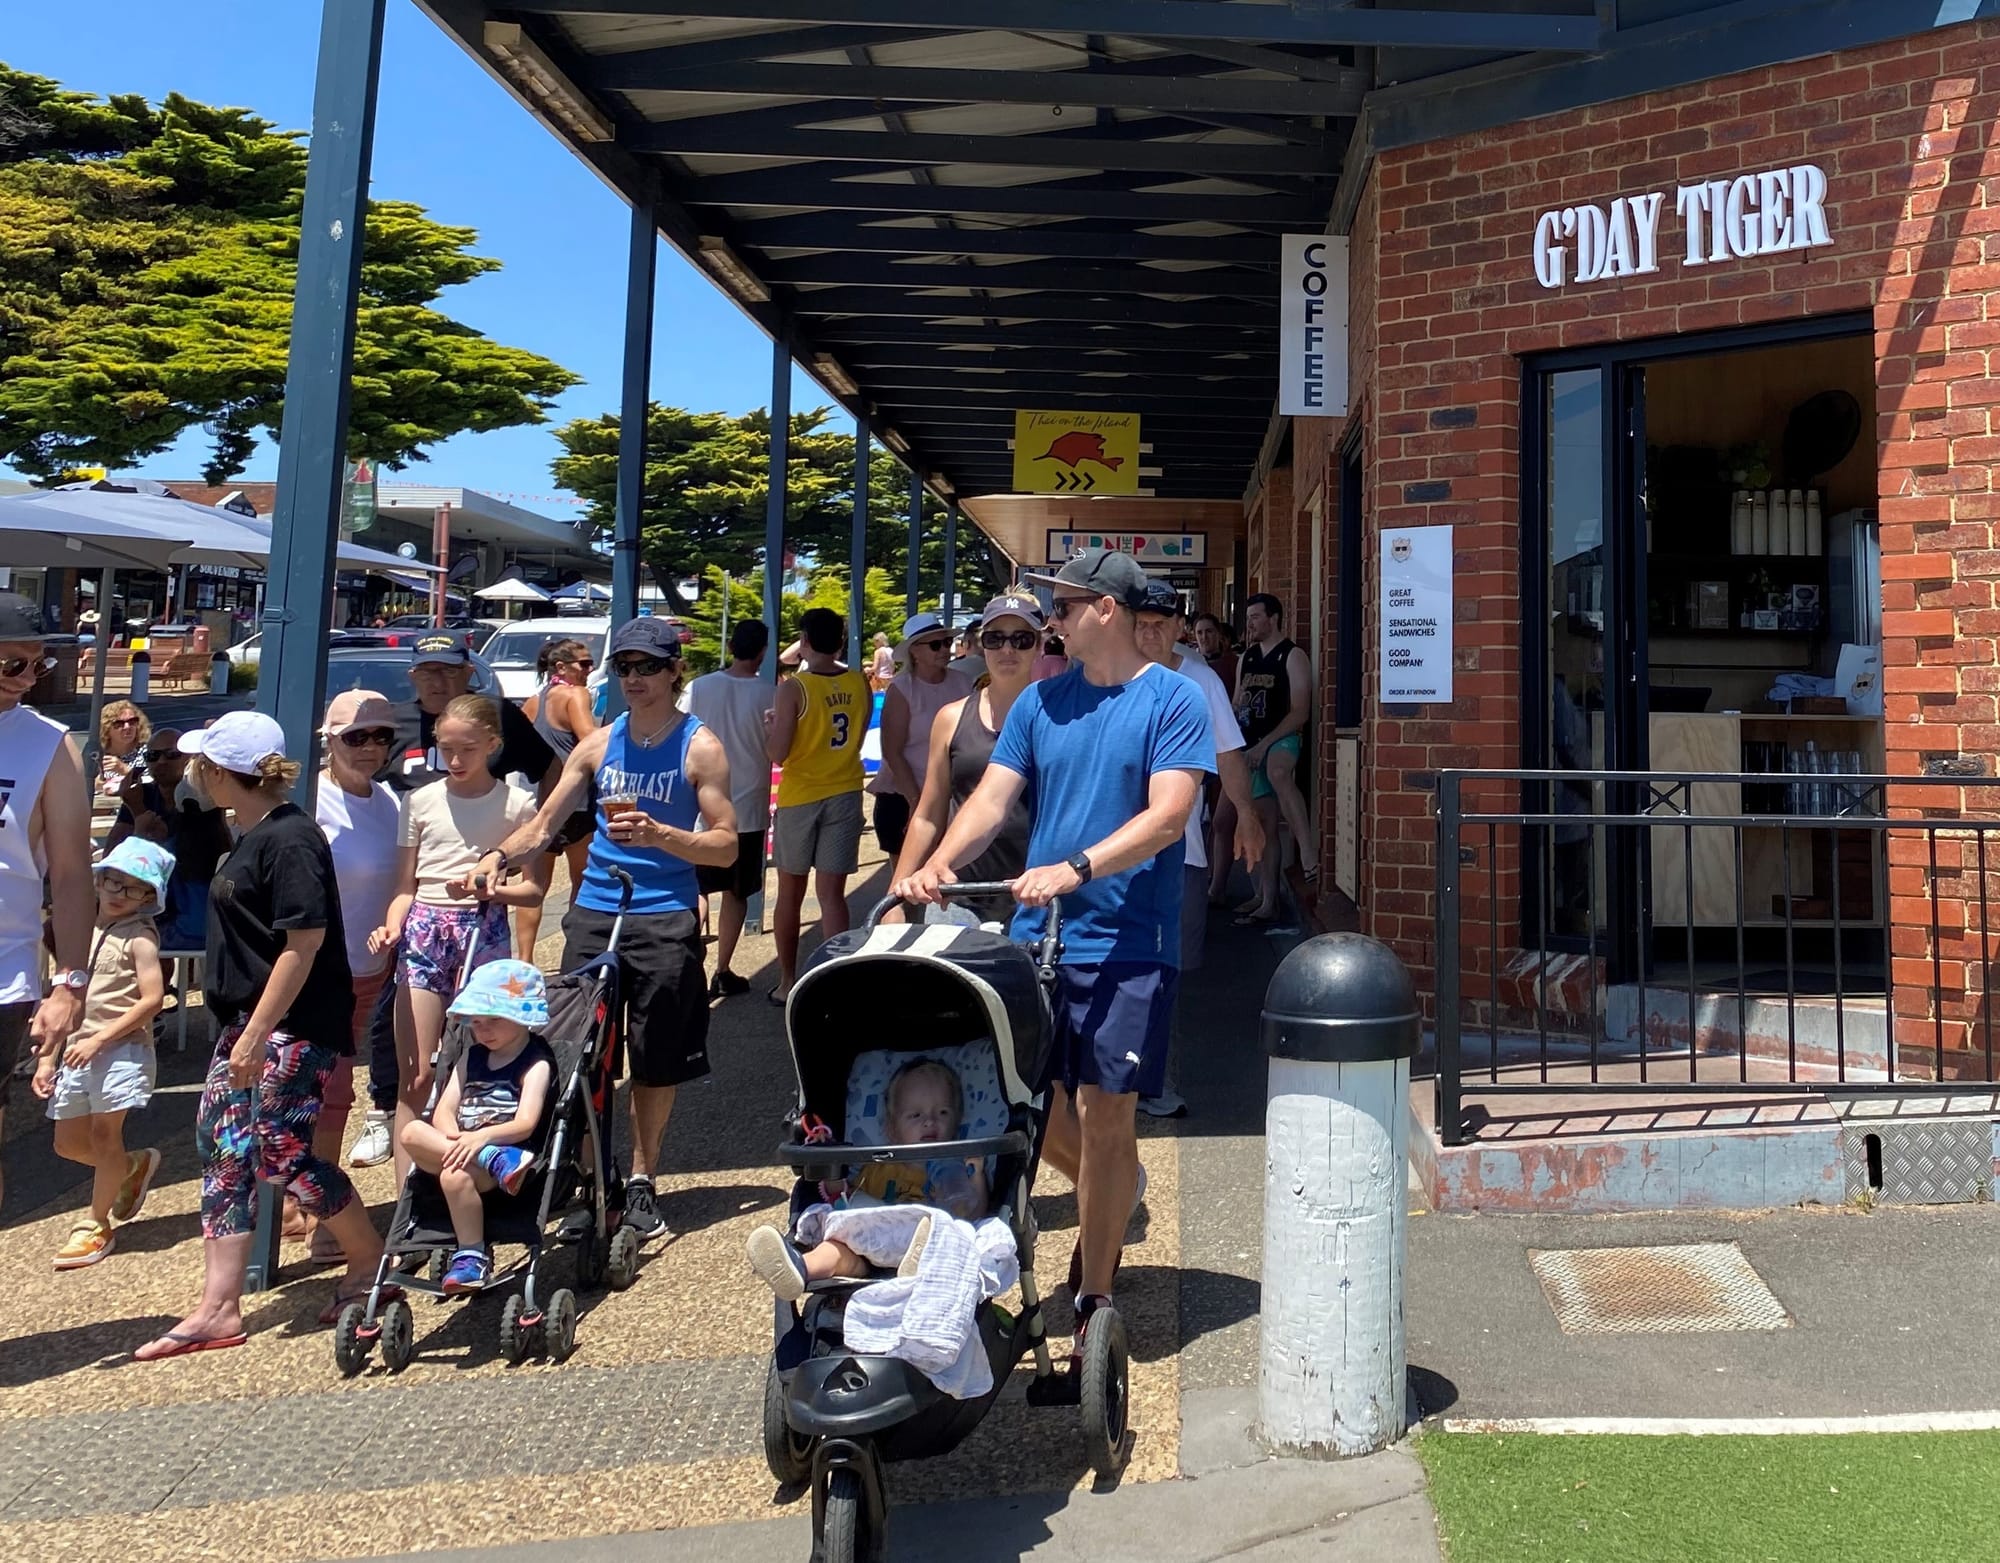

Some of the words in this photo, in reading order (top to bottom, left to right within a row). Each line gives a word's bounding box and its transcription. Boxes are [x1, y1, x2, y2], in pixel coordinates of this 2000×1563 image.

[1677, 164, 1834, 266] TIGER
[1302, 243, 1328, 407] COFFEE
[1025, 411, 1056, 430] Thai
[1073, 416, 1093, 427] the
[1091, 416, 1131, 431] Island
[1133, 536, 1192, 556] PAGE
[199, 565, 240, 578] SOUVENIRS
[1389, 589, 1412, 597] GREAT
[1389, 599, 1415, 607] COFFEE
[1389, 619, 1437, 627] SENSATIONAL
[1389, 628, 1435, 637] SANDWICHES
[1388, 649, 1410, 657] GOOD
[1388, 659, 1424, 667] COMPANY
[825, 692, 853, 707] DAVIS
[830, 711, 849, 750] 3
[600, 765, 679, 804] EVERLAST
